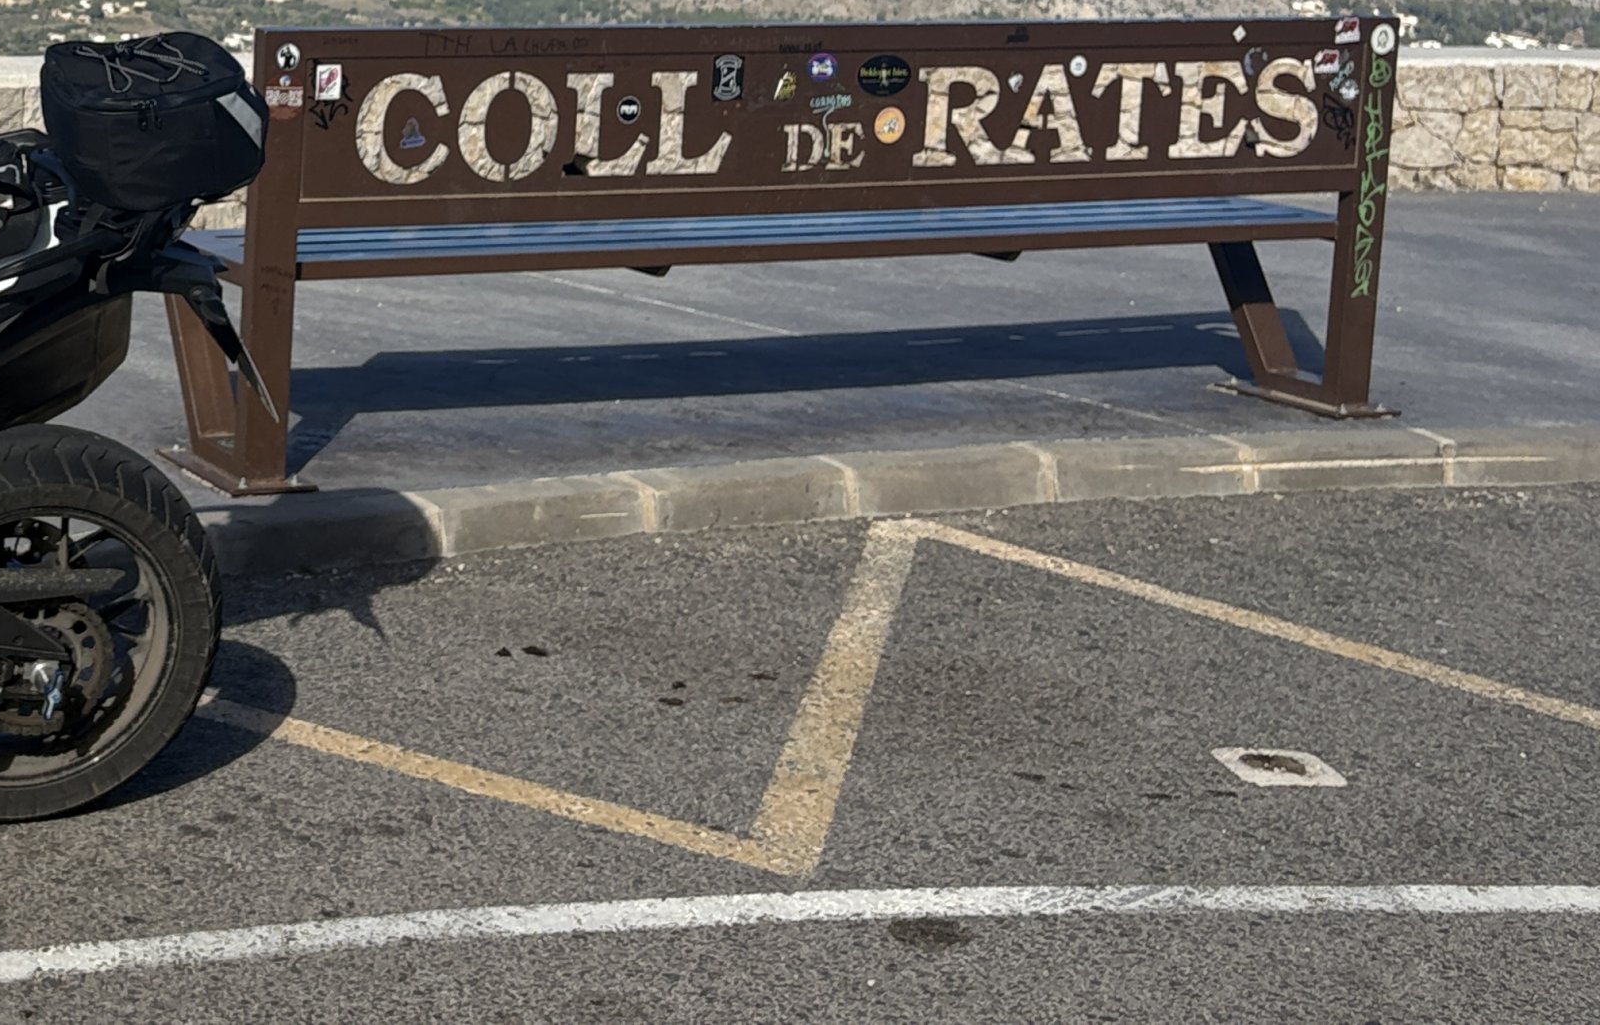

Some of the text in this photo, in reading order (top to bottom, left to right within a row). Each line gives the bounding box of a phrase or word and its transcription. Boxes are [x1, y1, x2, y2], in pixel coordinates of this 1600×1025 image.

[355, 71, 734, 185] COLL
[781, 122, 866, 172] DE
[912, 56, 1320, 168] RATES
